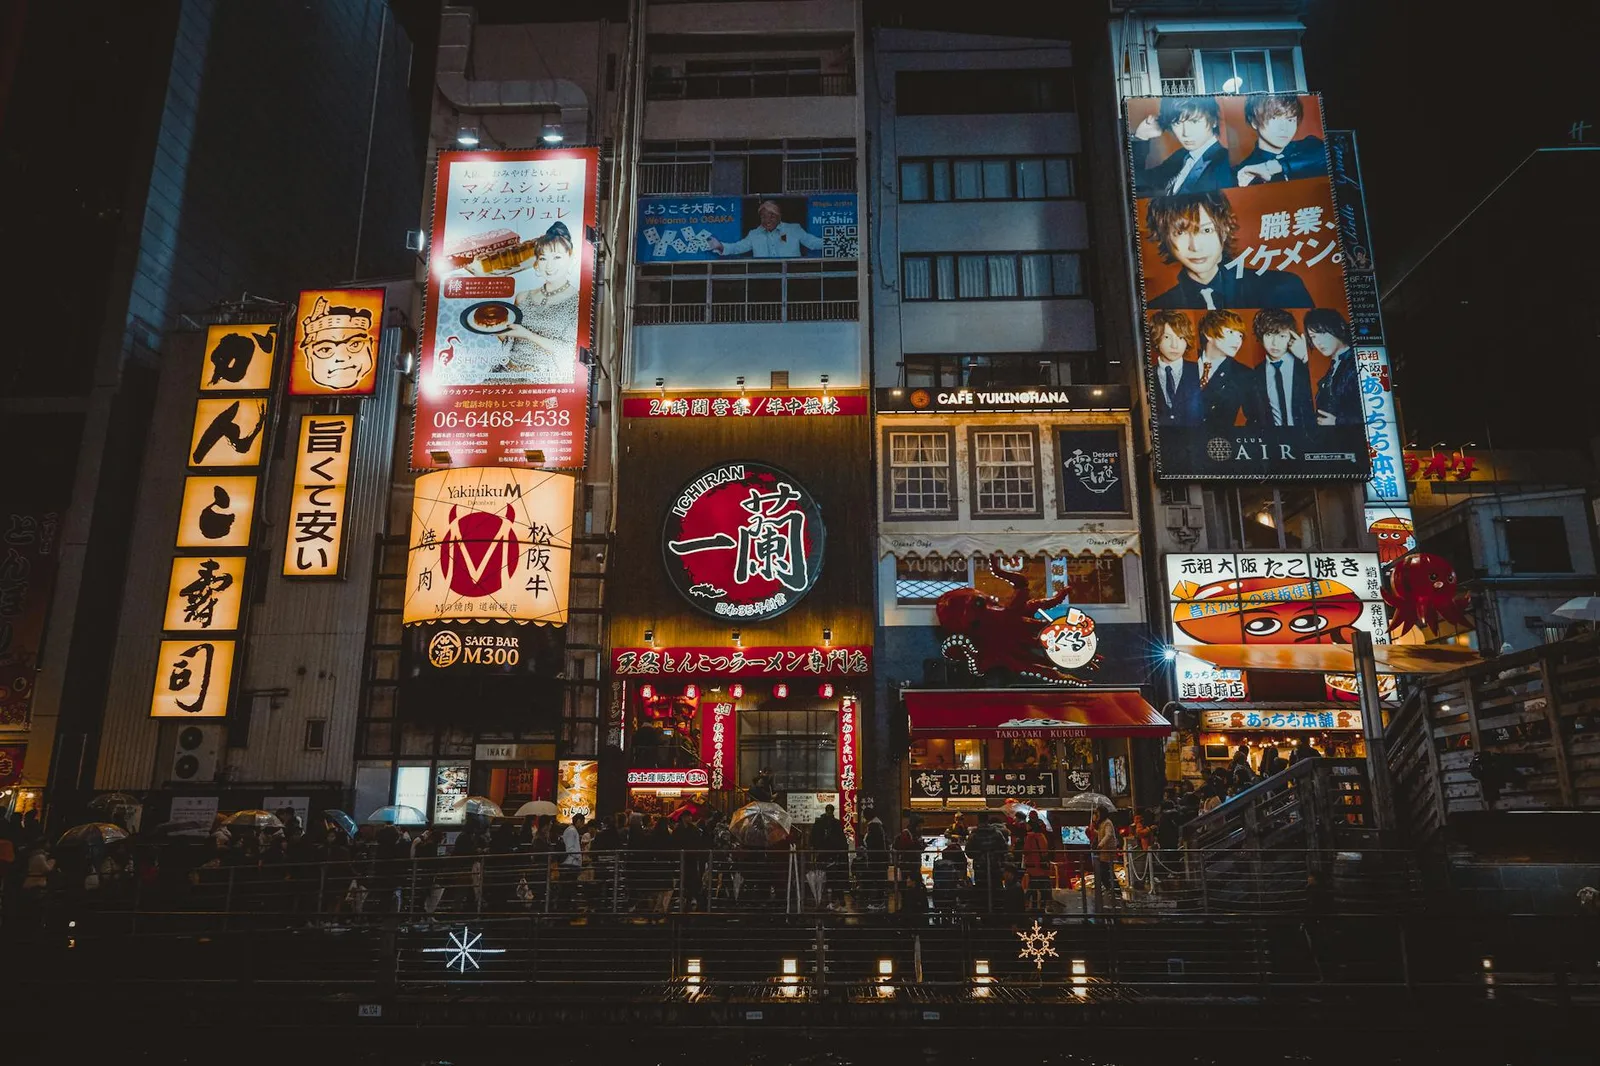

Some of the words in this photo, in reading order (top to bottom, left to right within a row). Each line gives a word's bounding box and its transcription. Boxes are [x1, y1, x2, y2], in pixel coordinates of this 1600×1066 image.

[462, 181, 570, 195] マダムシンコ
[459, 195, 571, 206] マダムシンコといえば。
[459, 206, 571, 223] マダムブリュレ
[645, 217, 687, 225] Welcome
[690, 216, 698, 224] to
[701, 215, 735, 224] OSAKA
[812, 216, 854, 225] Mr.Shin
[1259, 206, 1336, 241] 職業、
[1224, 238, 1343, 279] イケメン。
[1358, 350, 1380, 361] 元祖
[1359, 362, 1382, 374] 大阪
[454, 398, 546, 410] お電話お待ちしております
[937, 391, 973, 405] CAFE
[977, 391, 1069, 405] YUKINOHANA
[433, 412, 571, 431] 06-6468-4538
[1361, 374, 1398, 498] あっちち本舗
[1235, 444, 1297, 461] AIR
[297, 419, 348, 571] 旨くて安い
[672, 464, 745, 518] ICHIRAN
[668, 482, 809, 591] 一蘭
[524, 521, 553, 599] 松阪牛
[1181, 557, 1360, 580] 元祖大阪たこ焼き
[465, 635, 495, 647] SAKE
[496, 635, 520, 648] BAR
[462, 647, 520, 666] M300
[615, 648, 869, 676] 天然とんこつラーメン専門店
[1182, 682, 1244, 699] 道頓堀店
[1247, 711, 1335, 728] あっちち本舗
[996, 728, 1042, 739] TAKO-YAKI
[1050, 727, 1087, 738] KUKURU
[487, 748, 511, 758] INAKA
[627, 771, 686, 784] お土産販売所
[949, 773, 982, 785] 入口は
